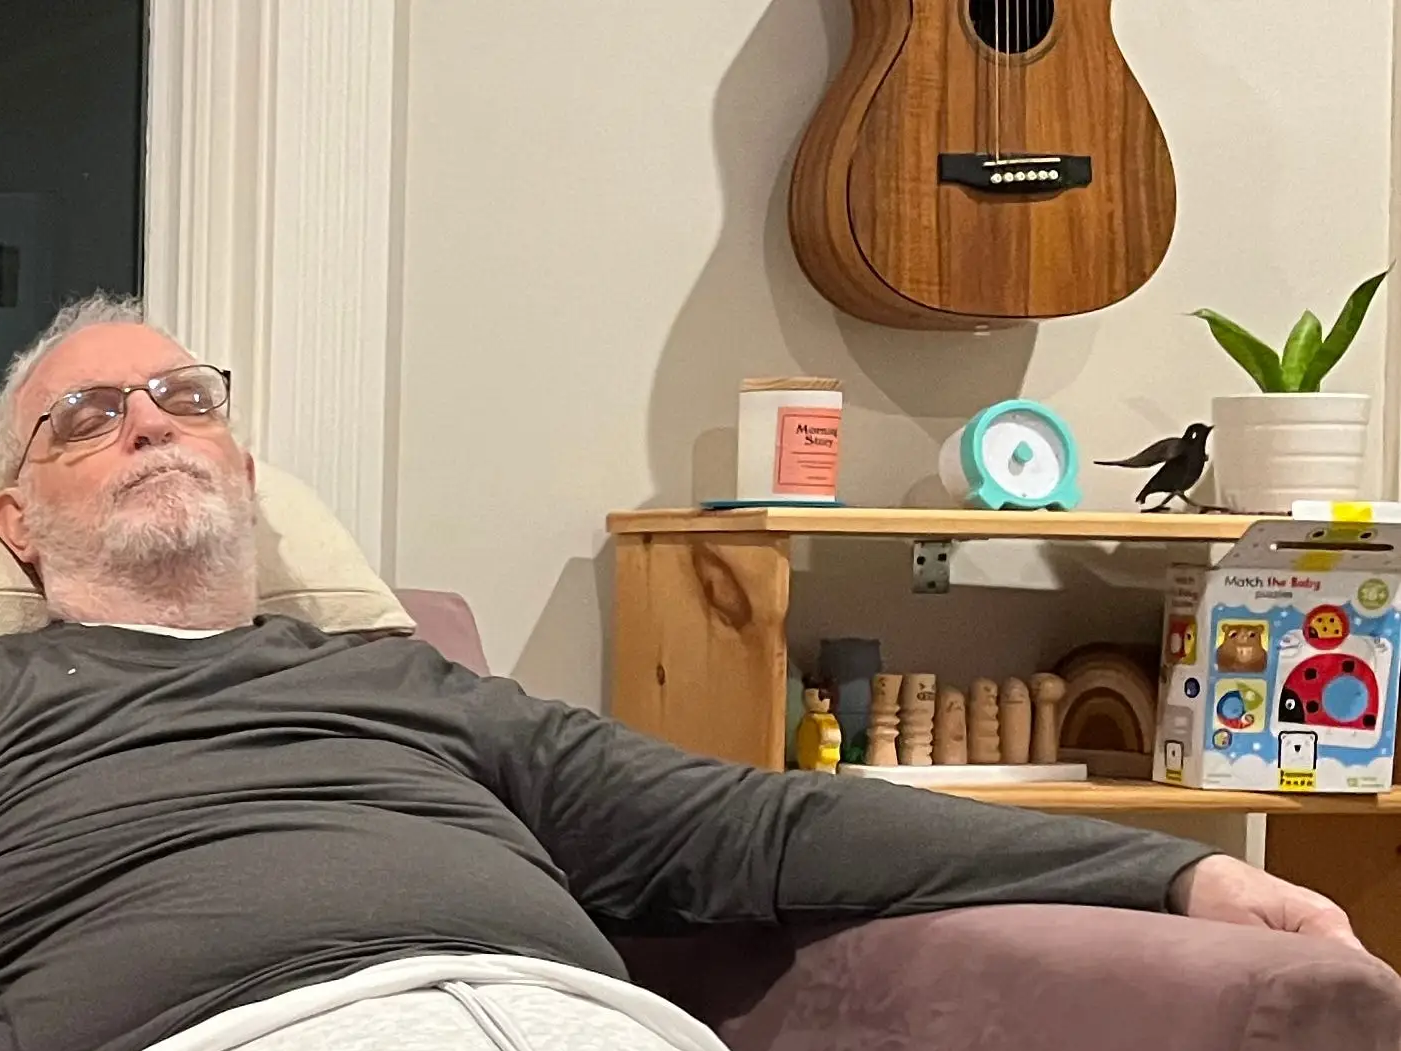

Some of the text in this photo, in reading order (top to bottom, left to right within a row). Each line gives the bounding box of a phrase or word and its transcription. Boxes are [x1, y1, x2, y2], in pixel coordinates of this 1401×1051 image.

[1224, 575, 1322, 591] Match the Baby
